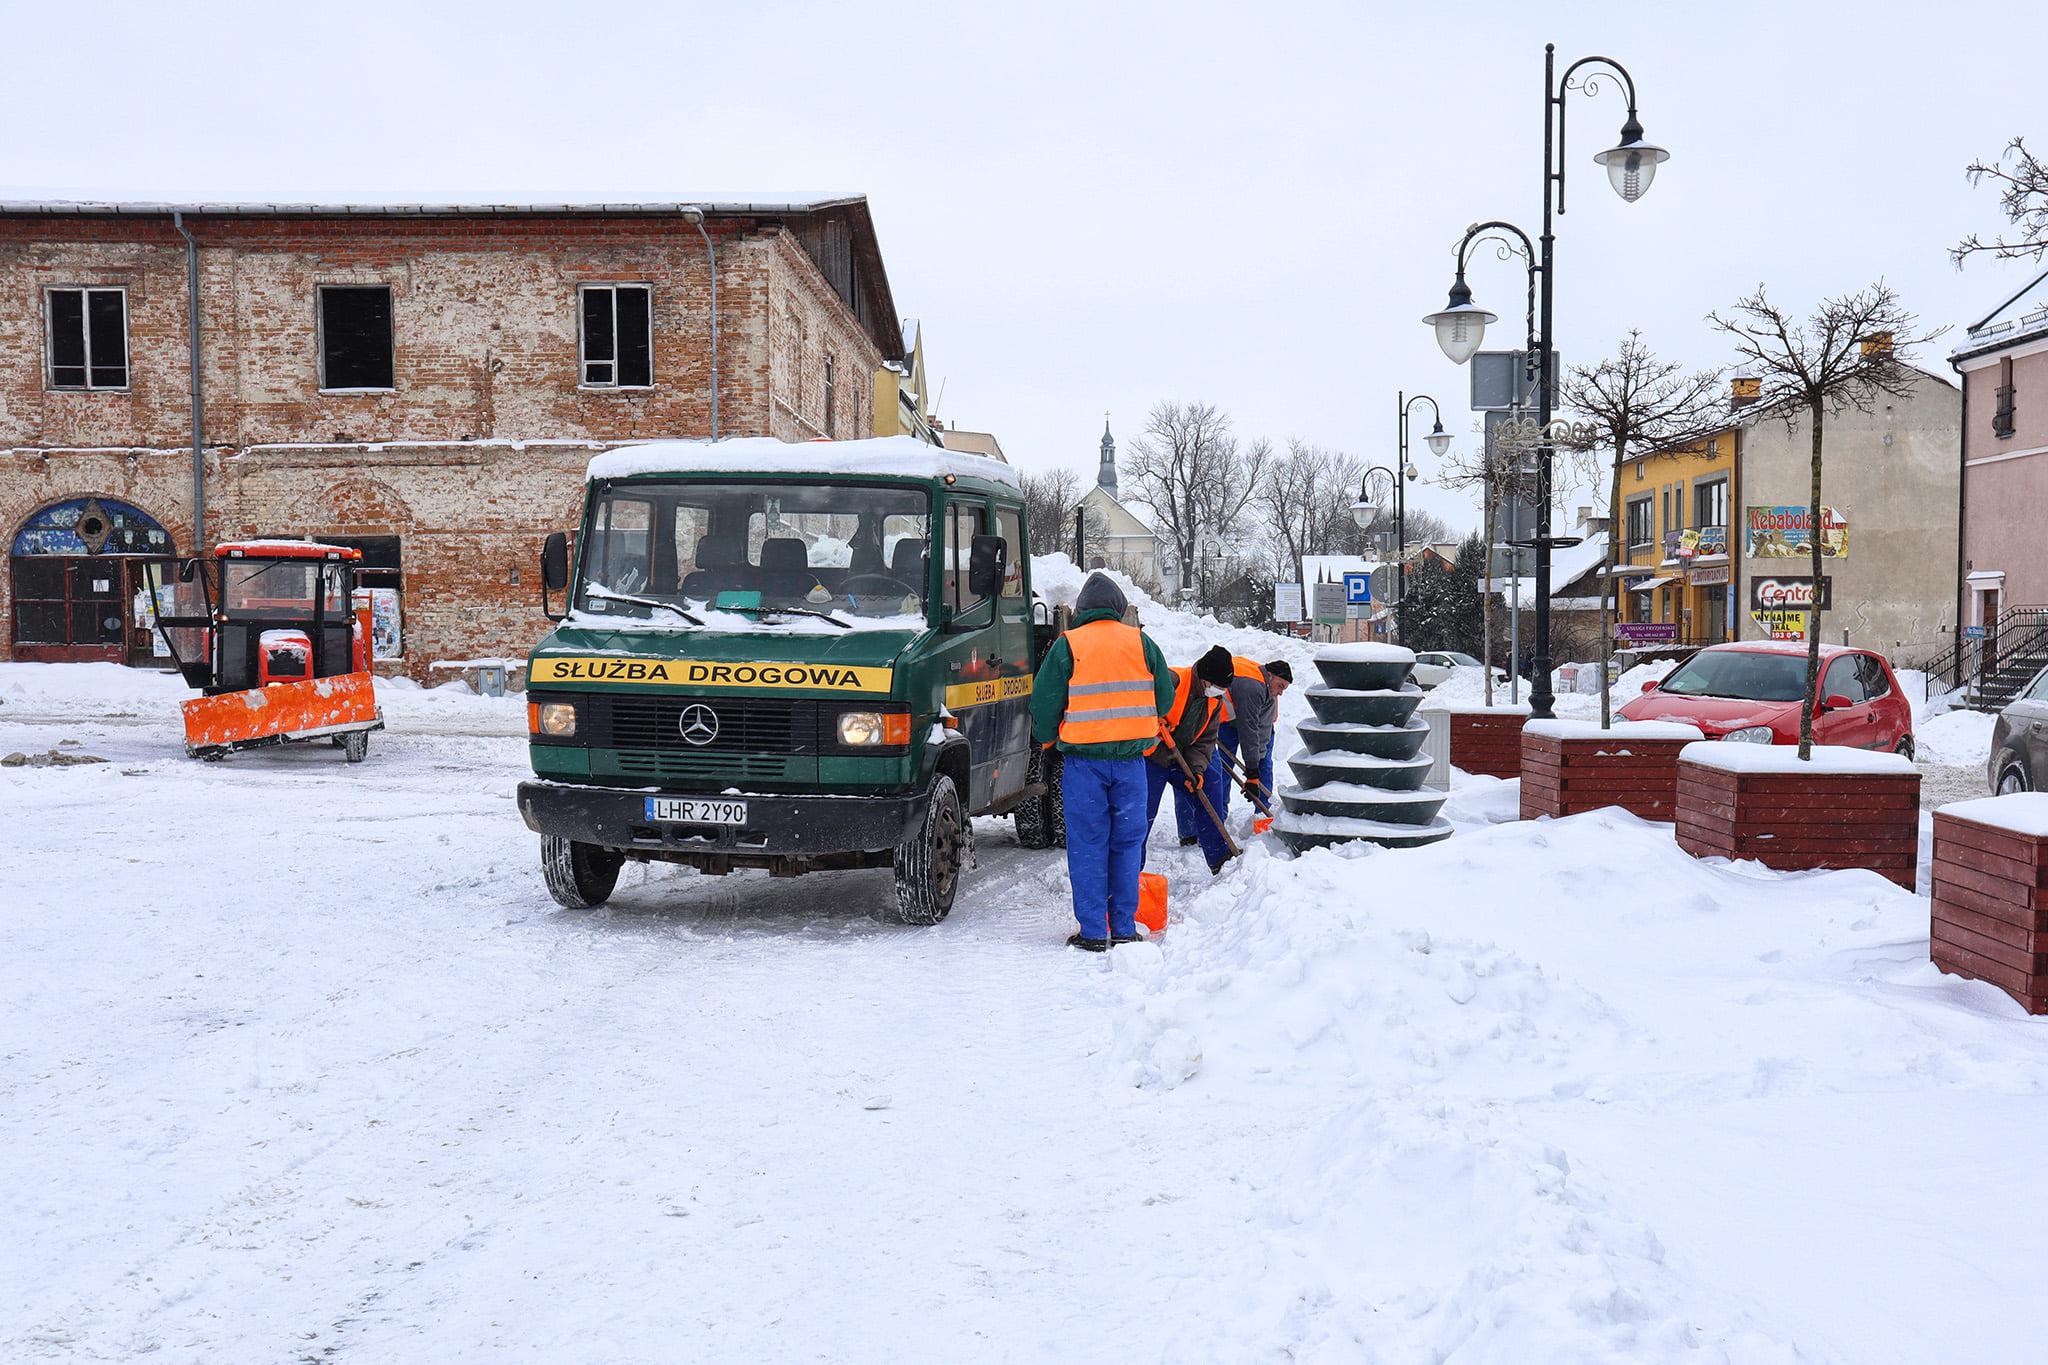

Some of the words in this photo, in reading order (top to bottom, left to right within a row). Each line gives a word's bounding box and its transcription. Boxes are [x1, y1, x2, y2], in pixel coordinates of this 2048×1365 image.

[1750, 509, 1845, 530] Kebabolad
[1349, 578, 1365, 600] P
[1755, 613, 1801, 624] WYNAMĘ
[553, 659, 669, 681] SŁUŻBA
[688, 665, 862, 688] DROGOWA
[976, 684, 996, 702] SŁUŻBA
[1003, 677, 1029, 696] DROGOWA
[658, 801, 694, 820] LHR
[701, 803, 743, 822] 2Y90
